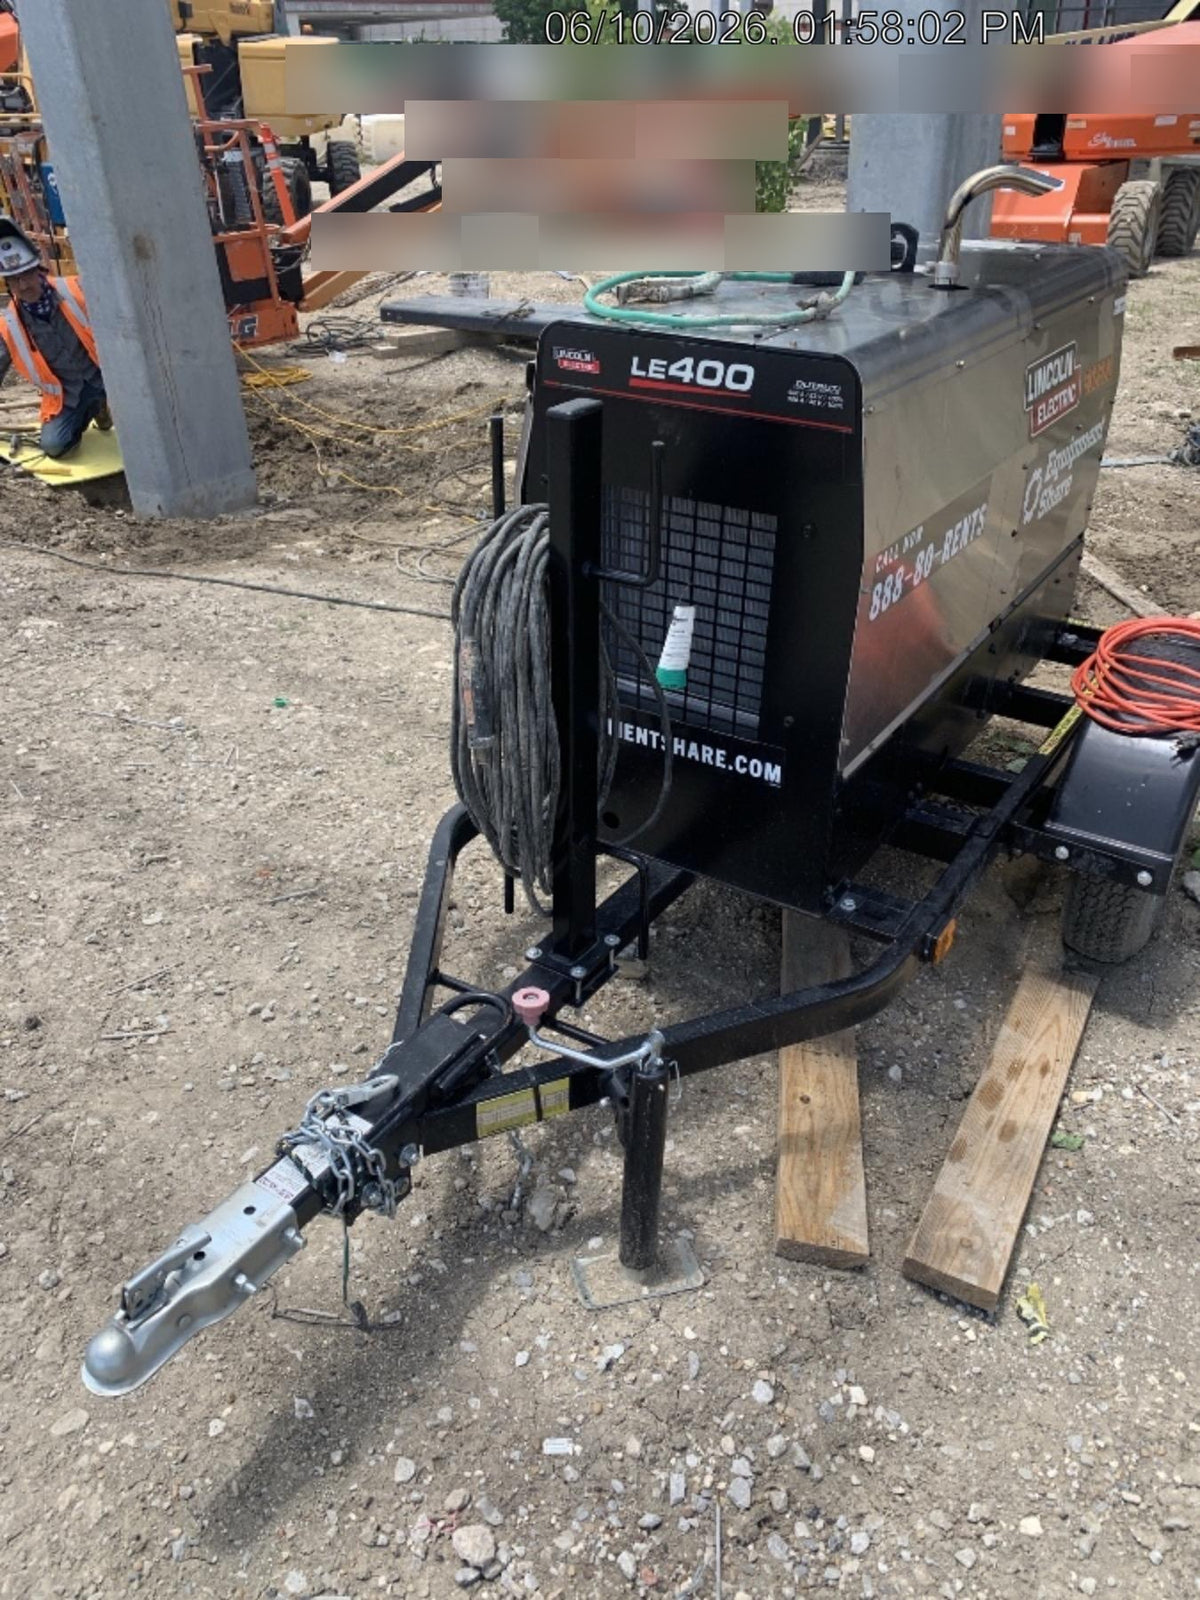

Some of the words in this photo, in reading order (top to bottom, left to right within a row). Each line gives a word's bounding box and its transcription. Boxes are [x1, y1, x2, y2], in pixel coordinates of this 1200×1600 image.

[630, 356, 756, 392] LE400
[1028, 350, 1074, 402] LINCOLN
[1037, 383, 1077, 426] ELECTRIC
[1044, 417, 1105, 483] Equipment
[1037, 474, 1073, 519] Share
[868, 503, 988, 622] 888-80-RENTS
[875, 543, 899, 574] CALL
